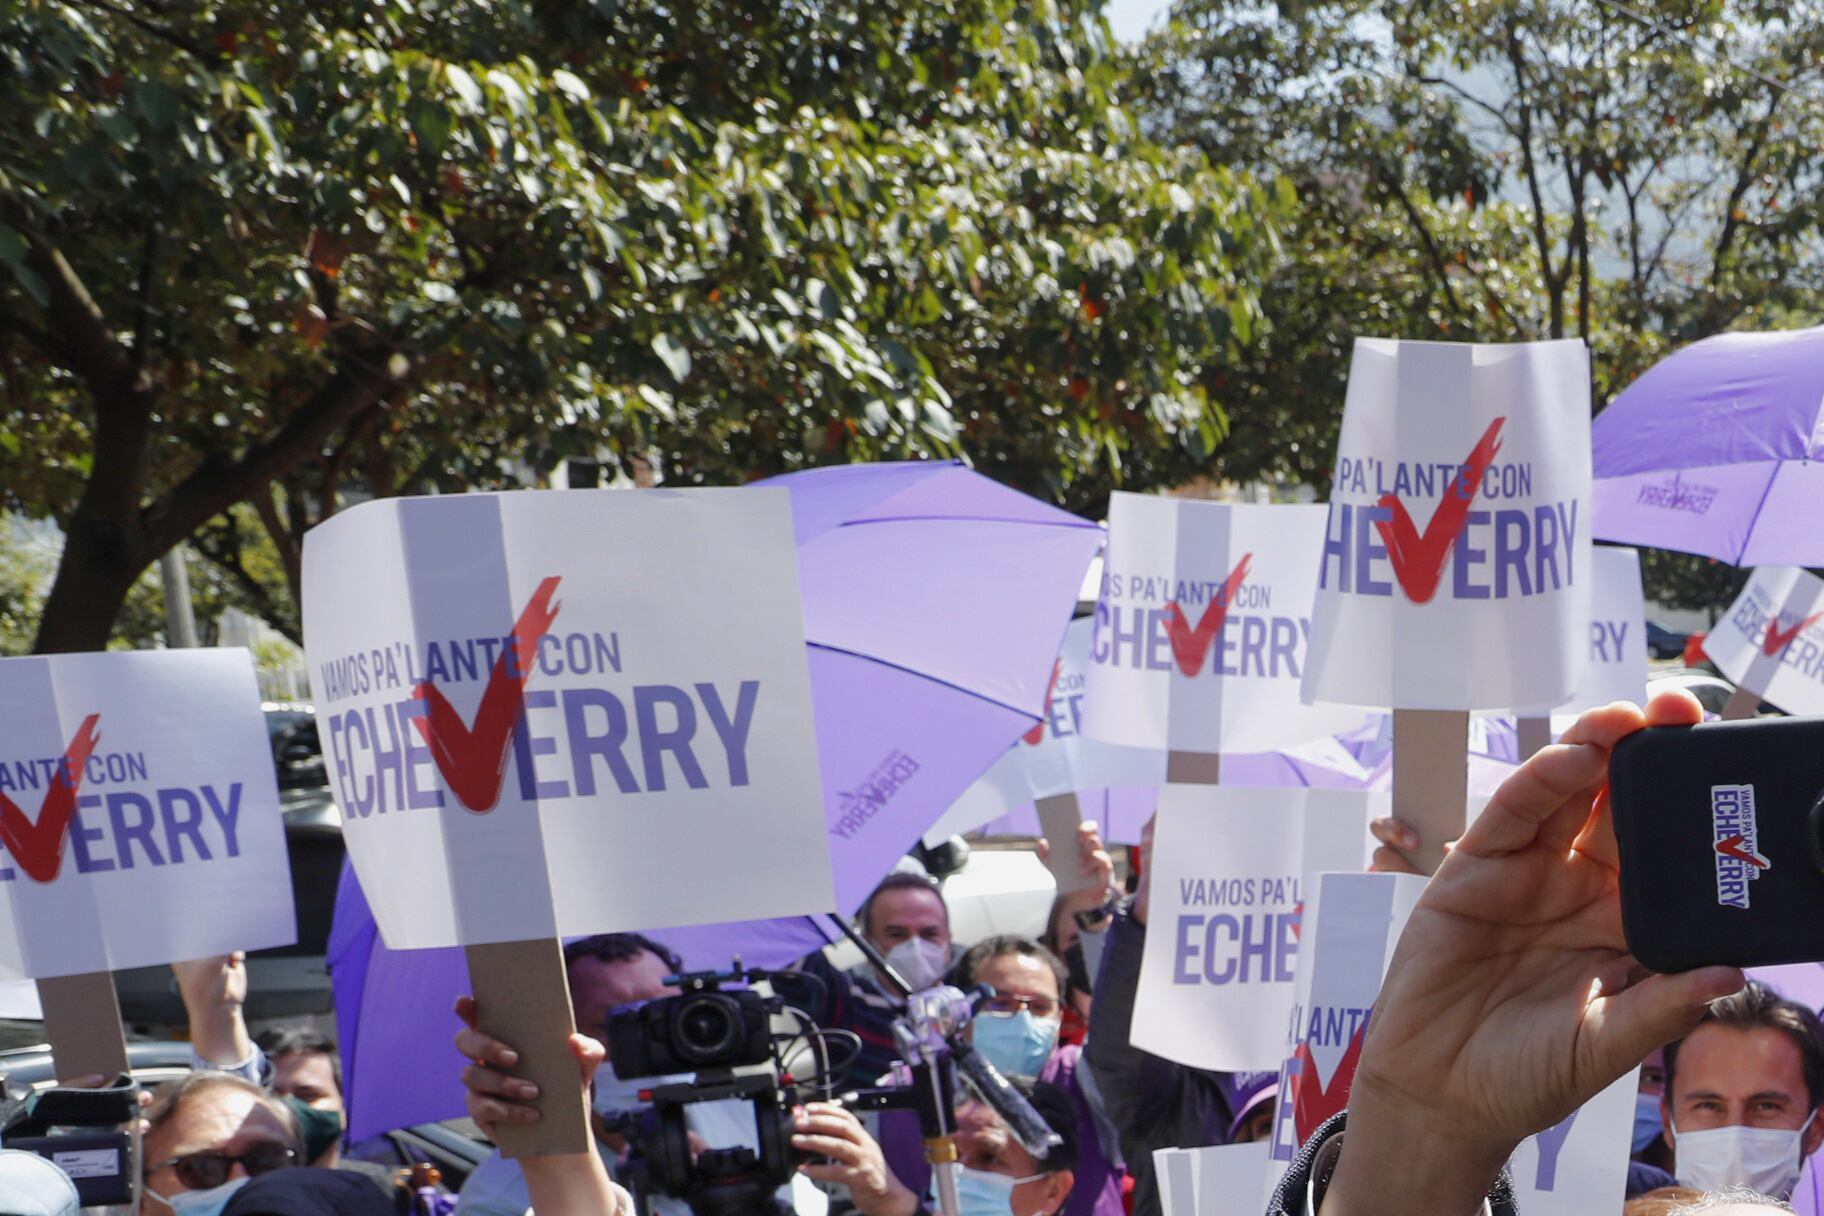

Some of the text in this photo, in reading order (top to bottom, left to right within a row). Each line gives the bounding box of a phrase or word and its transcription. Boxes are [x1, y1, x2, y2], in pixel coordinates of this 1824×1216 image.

[1482, 463, 1532, 500] CON
[1320, 499, 1578, 606] HEVERRY
[1235, 584, 1272, 609] CON
[320, 631, 623, 702] VAMOS PA'LANTE CON
[329, 680, 761, 819] ECHEVERRY
[83, 751, 148, 785] CON
[1740, 789, 1752, 820] VAMOS
[1714, 790, 1746, 909] ECHEVERRY
[1745, 863, 1756, 881] CON
[1180, 876, 1304, 906] VAMOS PA'L
